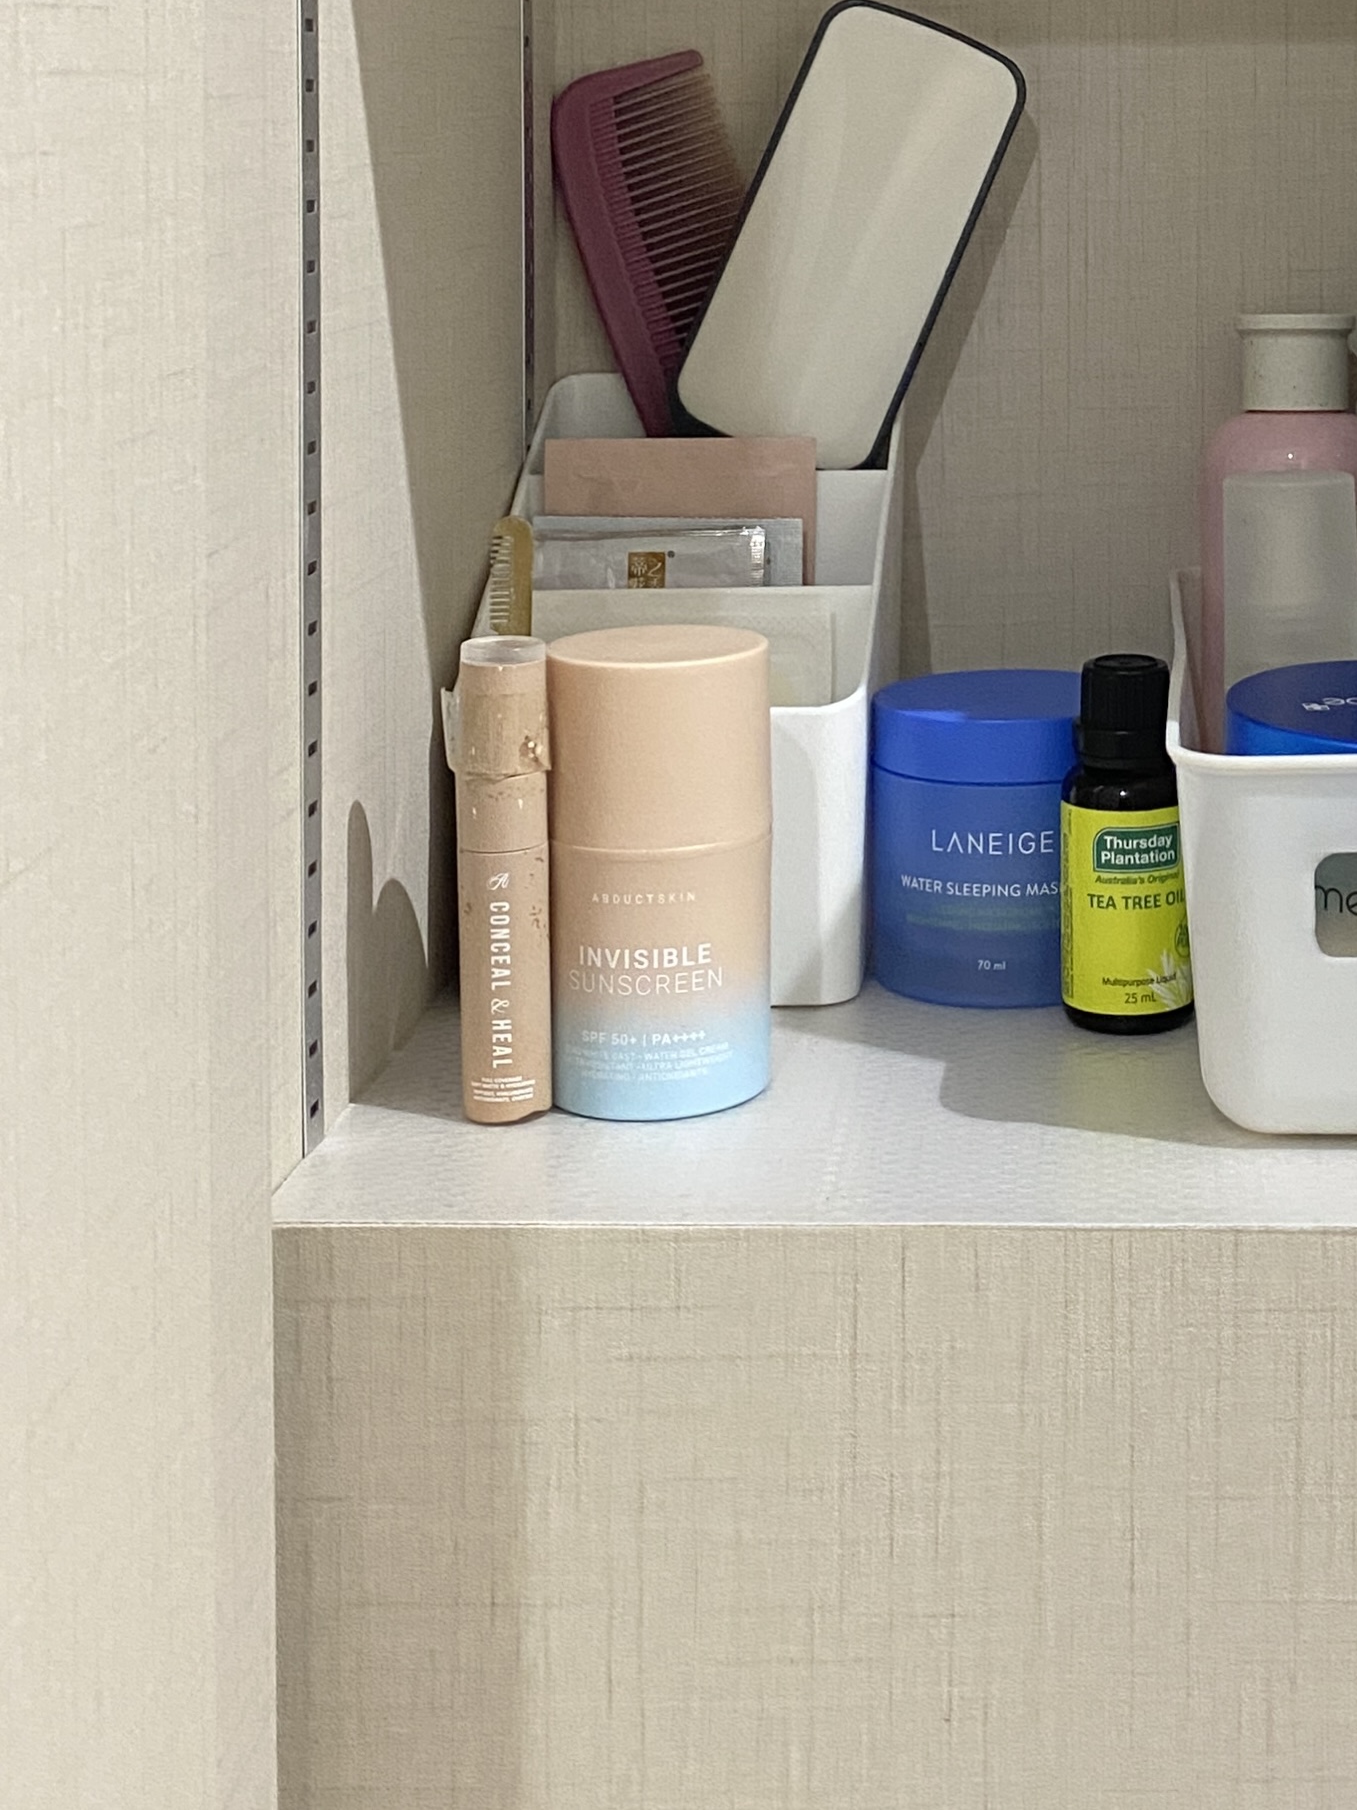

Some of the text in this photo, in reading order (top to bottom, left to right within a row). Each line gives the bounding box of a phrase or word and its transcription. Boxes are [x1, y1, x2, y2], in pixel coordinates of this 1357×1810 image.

[932, 829, 1055, 855] LANEIGE
[1103, 834, 1173, 850] Thursday
[1101, 849, 1176, 865] Plantation
[901, 874, 1059, 897] WATER SLEEPING MAS
[592, 892, 696, 905] ABDUCTSKIN
[1087, 893, 1118, 910] TEA
[1121, 893, 1162, 910] TREE
[489, 901, 511, 990] CONCEAL
[579, 943, 712, 970] INVISIBLE
[977, 959, 1006, 971] 70 ml
[569, 966, 723, 996] SUNSCREEN
[491, 998, 511, 1015] &
[1124, 993, 1138, 1004] 25
[492, 1019, 513, 1068] HEAL
[581, 1030, 607, 1044] SPF
[611, 1033, 637, 1046] 50+
[652, 1029, 706, 1045] PA++++
